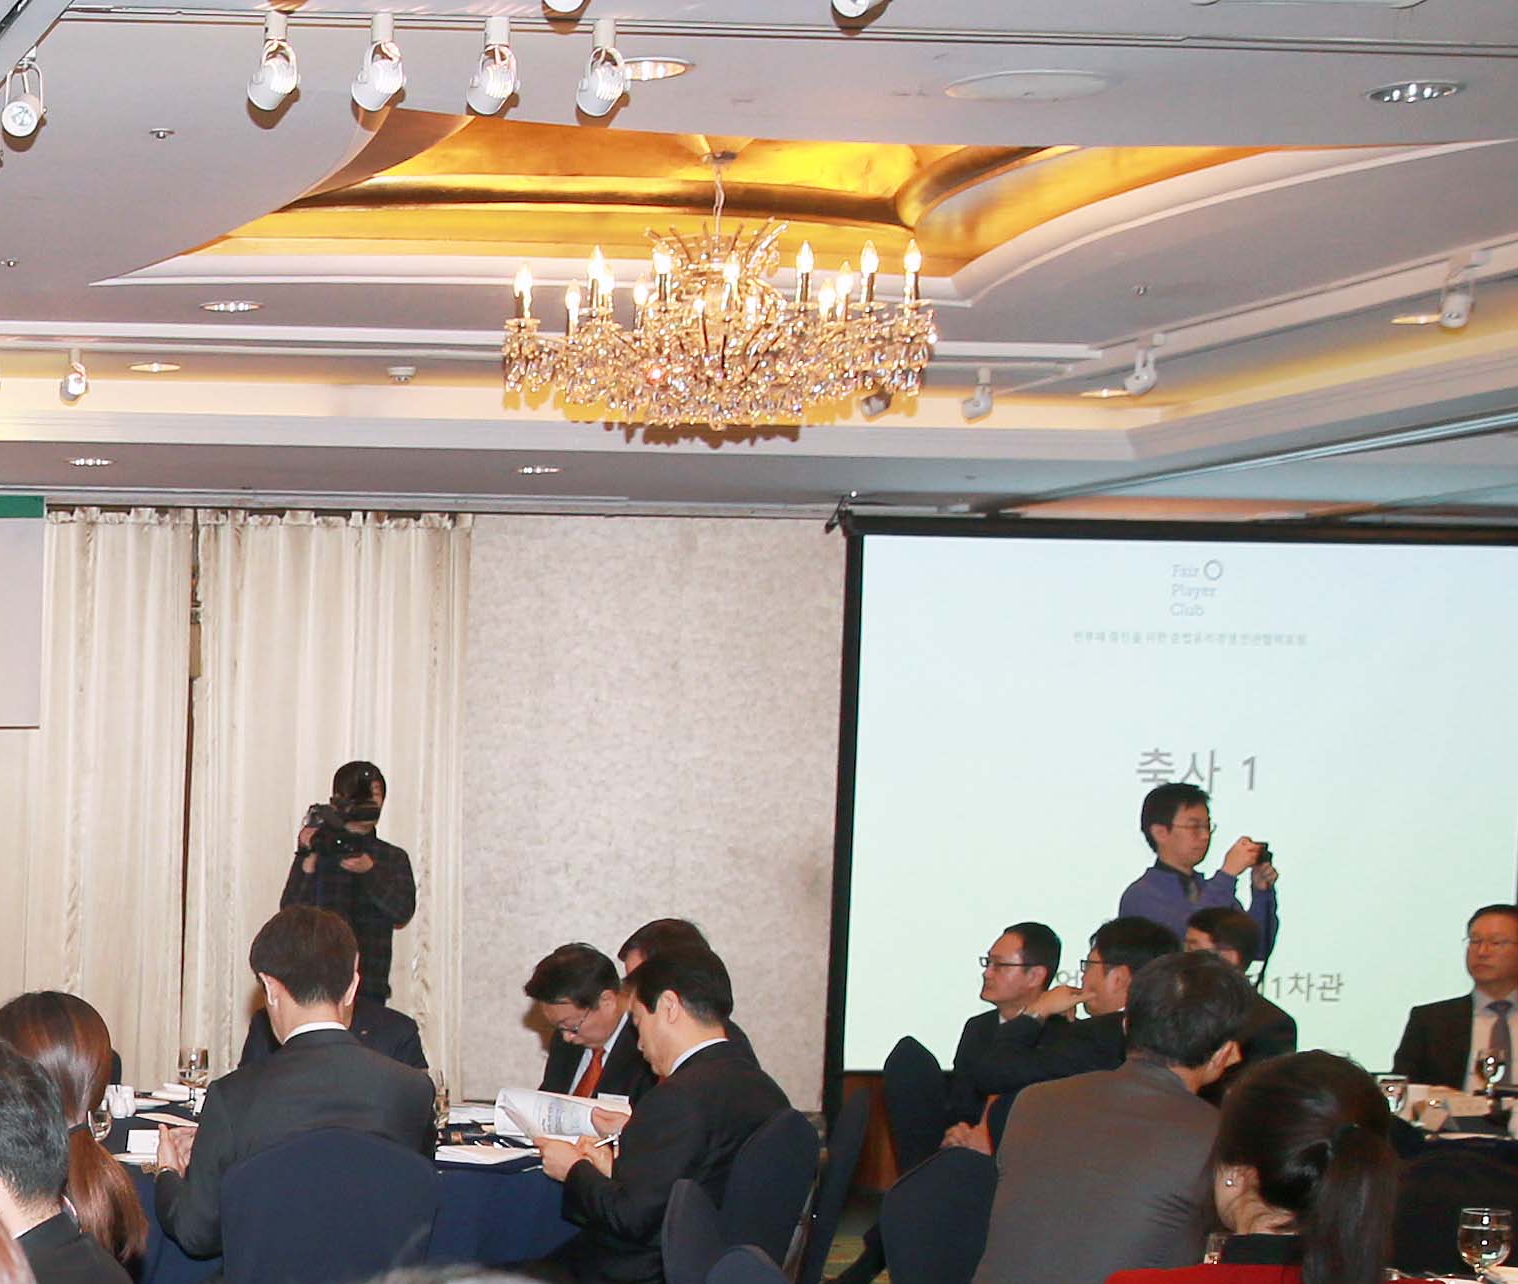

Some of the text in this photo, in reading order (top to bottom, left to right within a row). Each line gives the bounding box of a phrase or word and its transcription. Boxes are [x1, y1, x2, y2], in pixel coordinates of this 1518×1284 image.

[1136, 748, 1256, 793] 축사 1
[1269, 971, 1345, 1002] 1차관
